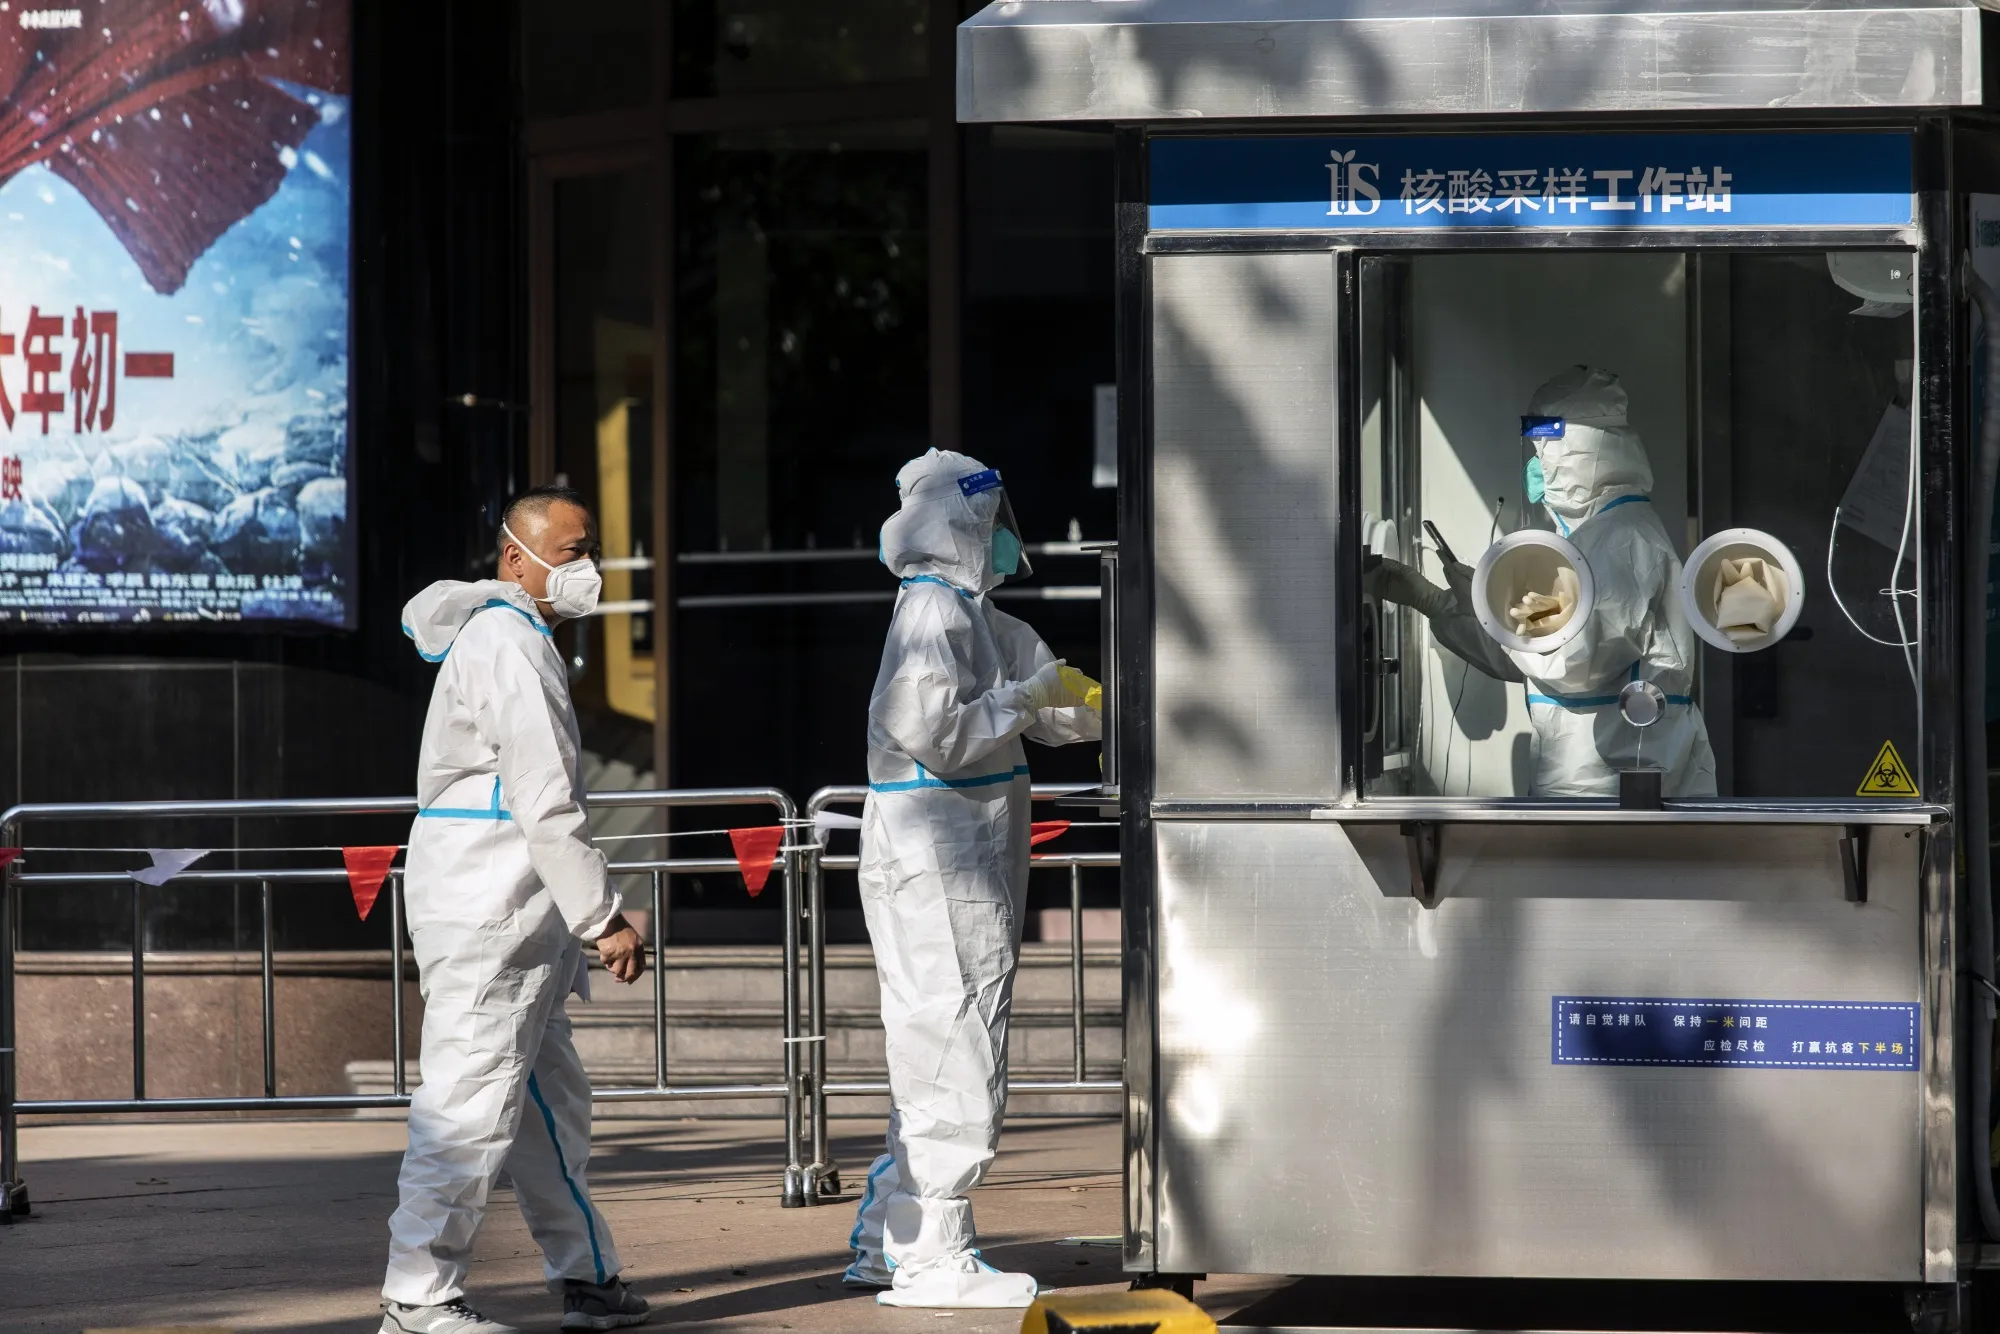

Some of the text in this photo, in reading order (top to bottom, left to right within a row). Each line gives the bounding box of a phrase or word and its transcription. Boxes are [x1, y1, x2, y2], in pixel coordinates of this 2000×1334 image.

[1400, 166, 1732, 214] 核酸采样工作站
[1568, 1012, 1768, 1029] 请自觉排队 保持一米间距
[1703, 1038, 1904, 1055] 应检尽检 打赢抗疫下半场
